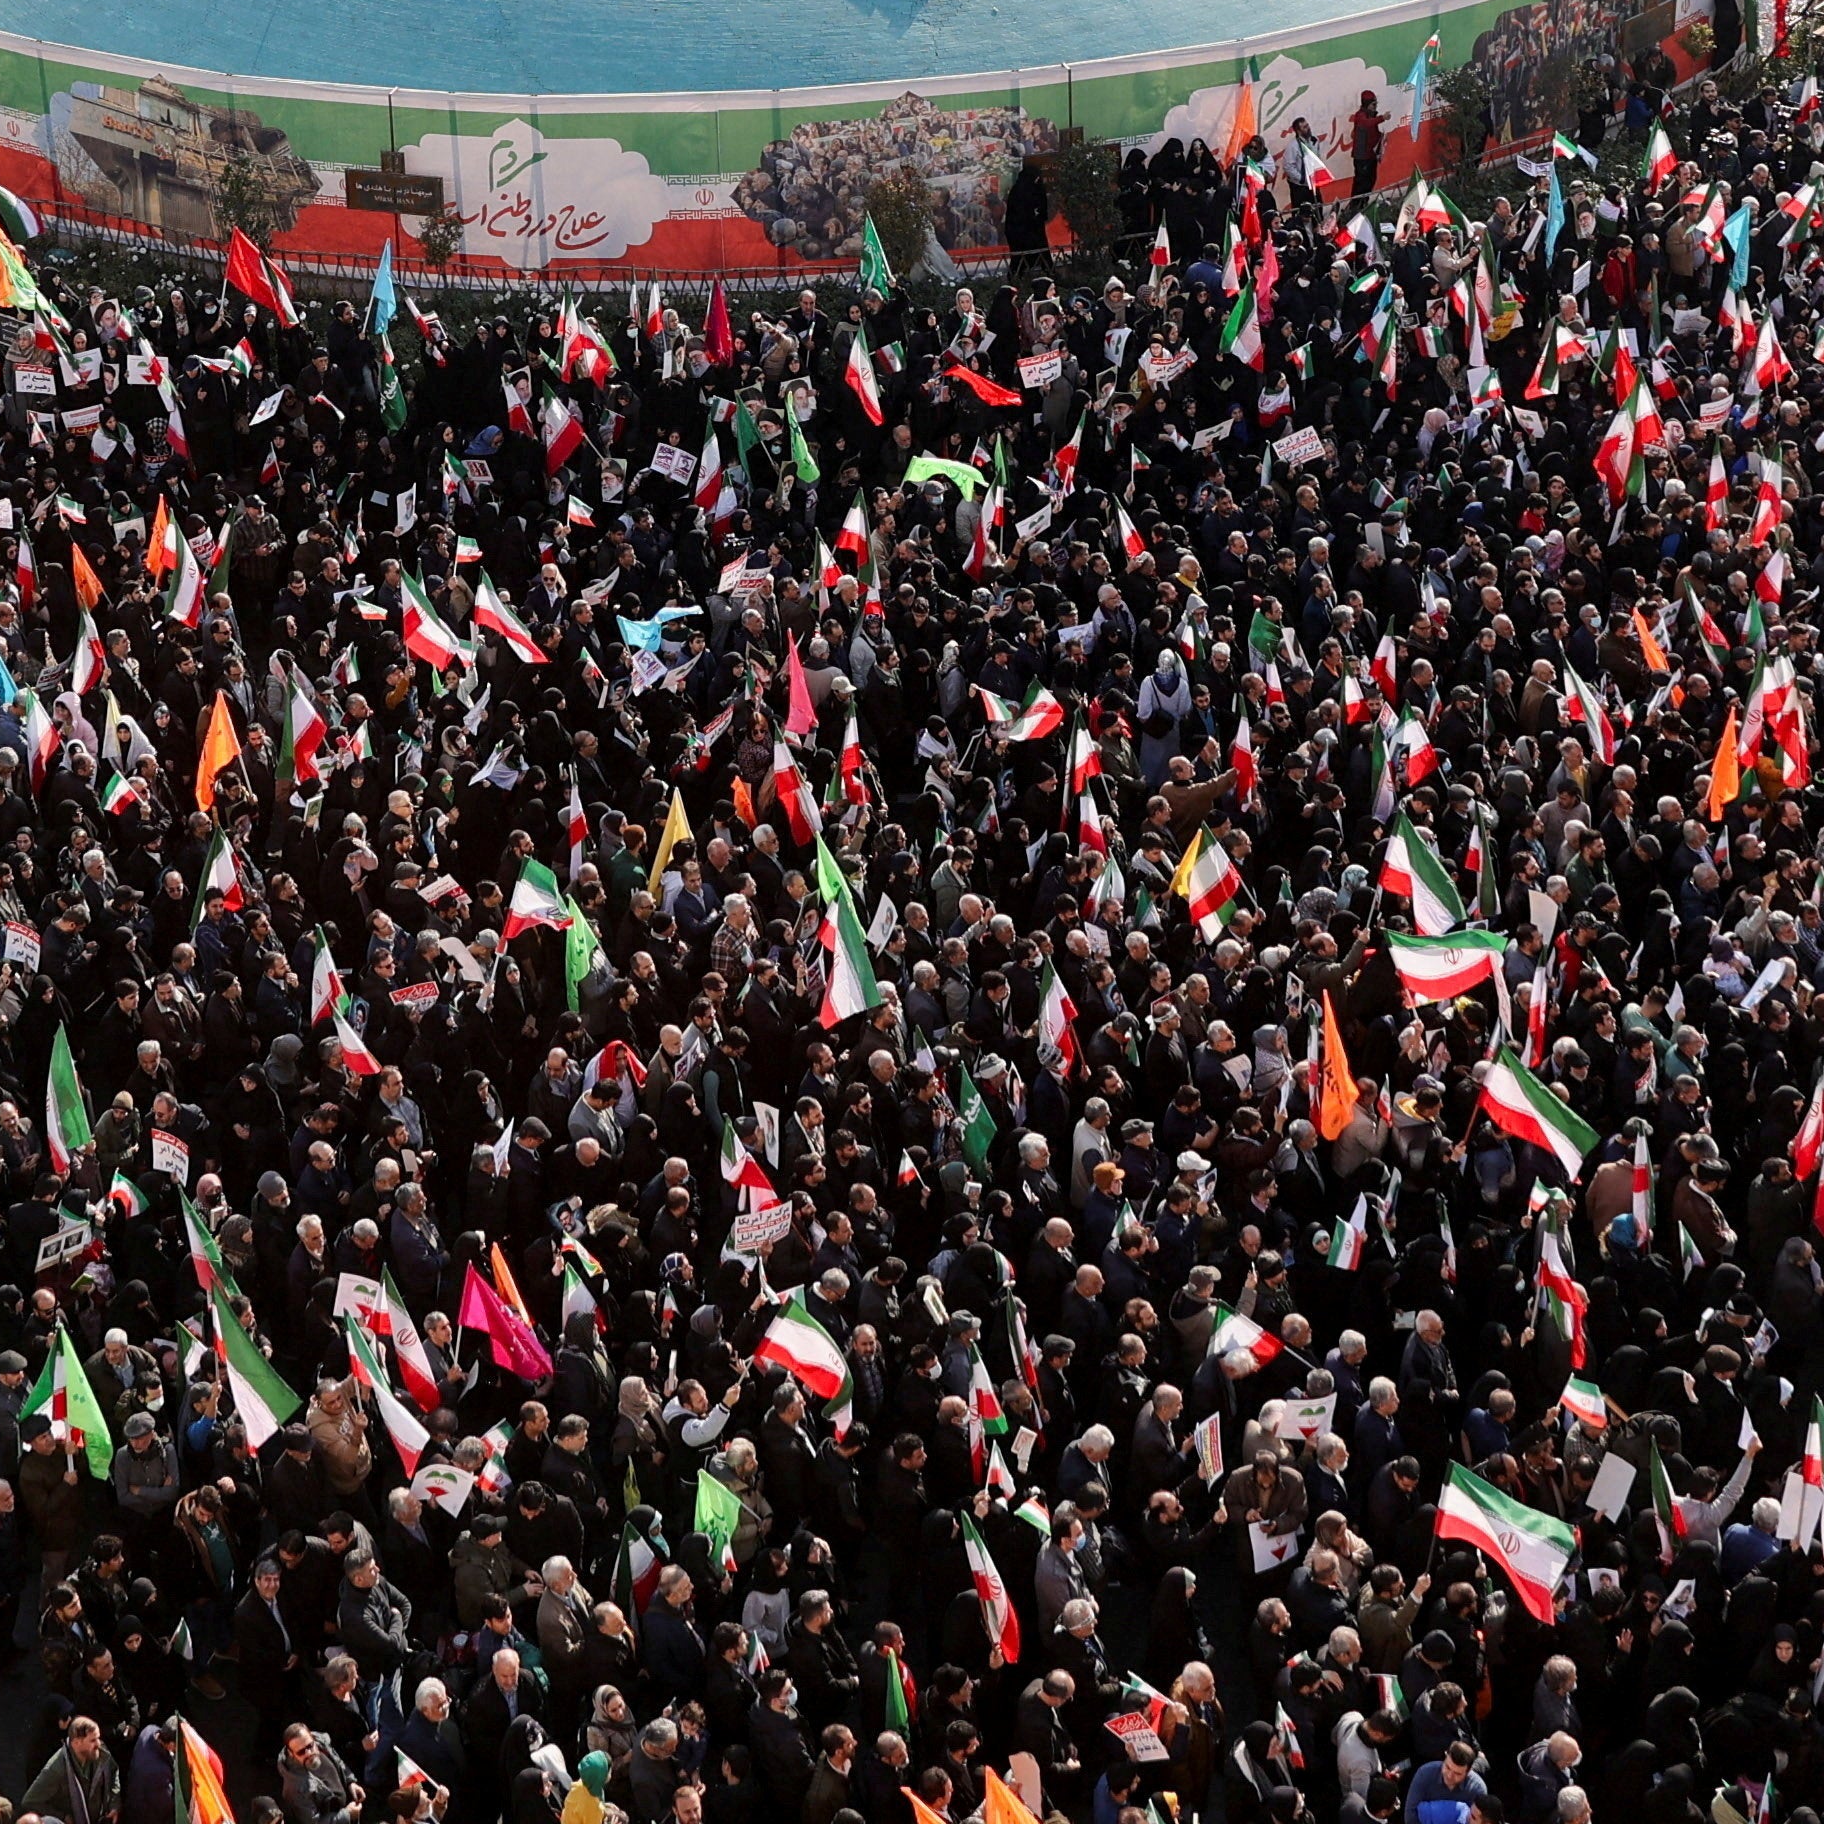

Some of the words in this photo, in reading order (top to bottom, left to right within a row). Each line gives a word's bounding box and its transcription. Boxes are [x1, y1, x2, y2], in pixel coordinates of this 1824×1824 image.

[1257, 80, 1309, 136] مردم
[489, 139, 548, 193] مردم
[487, 192, 532, 238] وطن
[529, 214, 557, 237] در
[555, 205, 609, 251] علاج
[1038, 362, 1057, 371] مطیع
[1027, 368, 1037, 376] امر
[21, 373, 31, 381] امر
[33, 374, 51, 382] مطیع
[26, 384, 51, 392] رهبریم
[766, 1209, 775, 1218] بر
[776, 1206, 789, 1215] مرگ
[738, 1212, 764, 1225] آمریکا
[766, 1227, 775, 1237] بر
[776, 1223, 788, 1232] مرگ
[737, 1231, 765, 1243] اسرائیل
